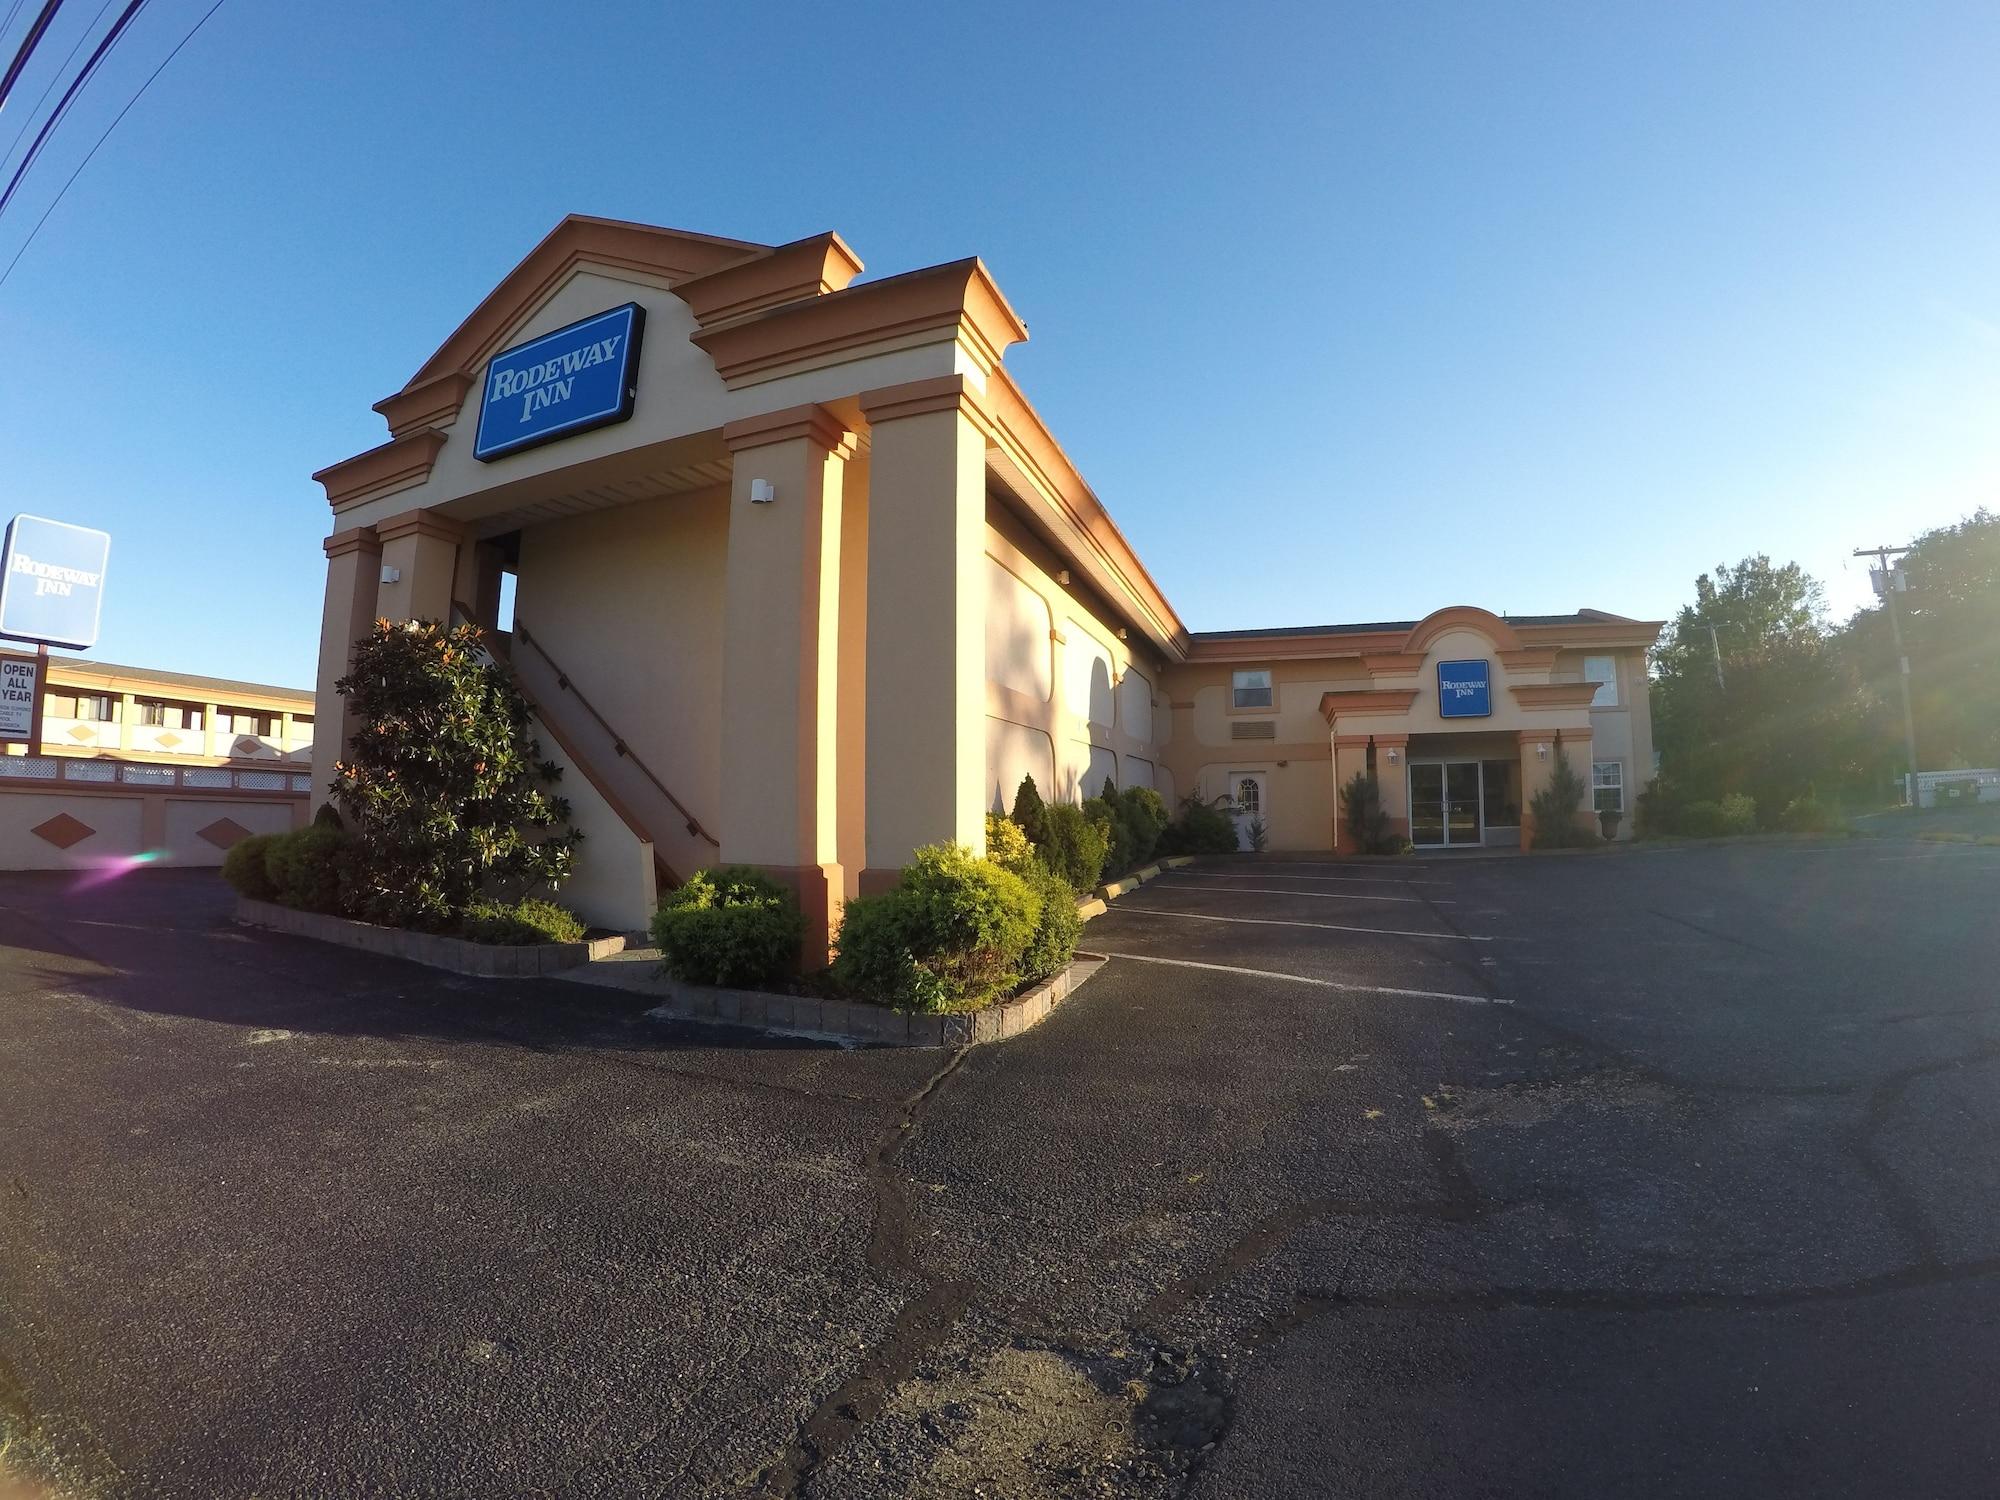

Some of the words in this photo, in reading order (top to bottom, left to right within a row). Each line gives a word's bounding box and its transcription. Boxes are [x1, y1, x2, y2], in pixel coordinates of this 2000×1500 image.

[490, 335, 622, 403] RODEWAY
[520, 377, 575, 423] INN
[12, 553, 100, 587] RODEWAY
[35, 578, 72, 596] INN
[3, 664, 34, 677] OPEN
[7, 677, 27, 689] ALL
[1442, 681, 1487, 690] RODEWAY
[2, 689, 31, 702] YEAR
[1456, 689, 1474, 698] INN
